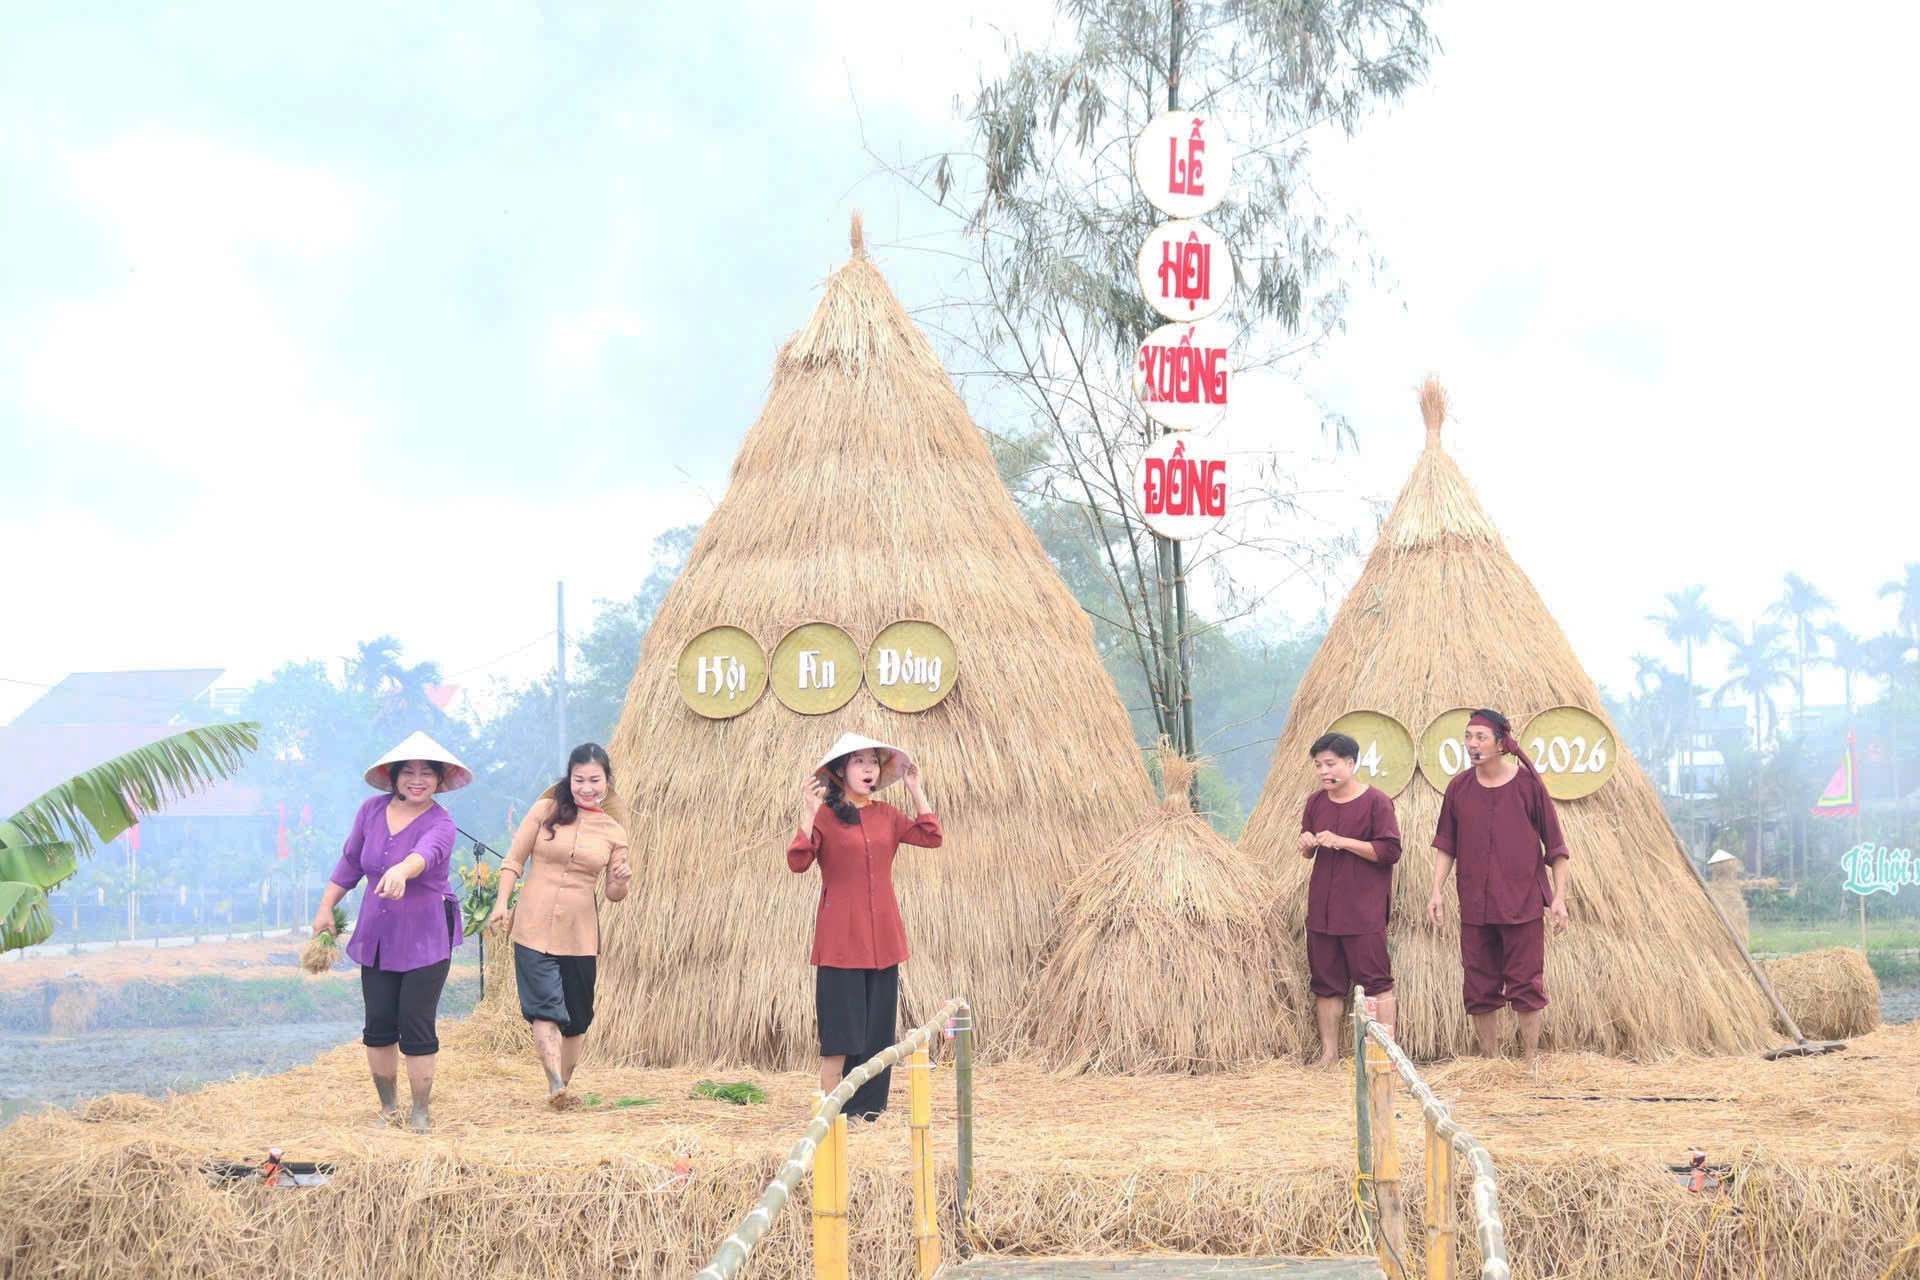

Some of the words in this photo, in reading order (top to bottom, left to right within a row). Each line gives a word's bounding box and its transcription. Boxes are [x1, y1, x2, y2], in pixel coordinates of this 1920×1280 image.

[1169, 117, 1205, 197] LỄ
[1158, 231, 1210, 311] HỘI
[1139, 326, 1228, 405] XUỐNG
[1143, 440, 1226, 516] ĐỒNG
[697, 656, 746, 700] Hội
[798, 651, 835, 689] An
[876, 647, 942, 692] Đông
[1529, 735, 1608, 774] 2026
[1841, 842, 1884, 895] Lễ
[1876, 846, 1911, 895] hội
